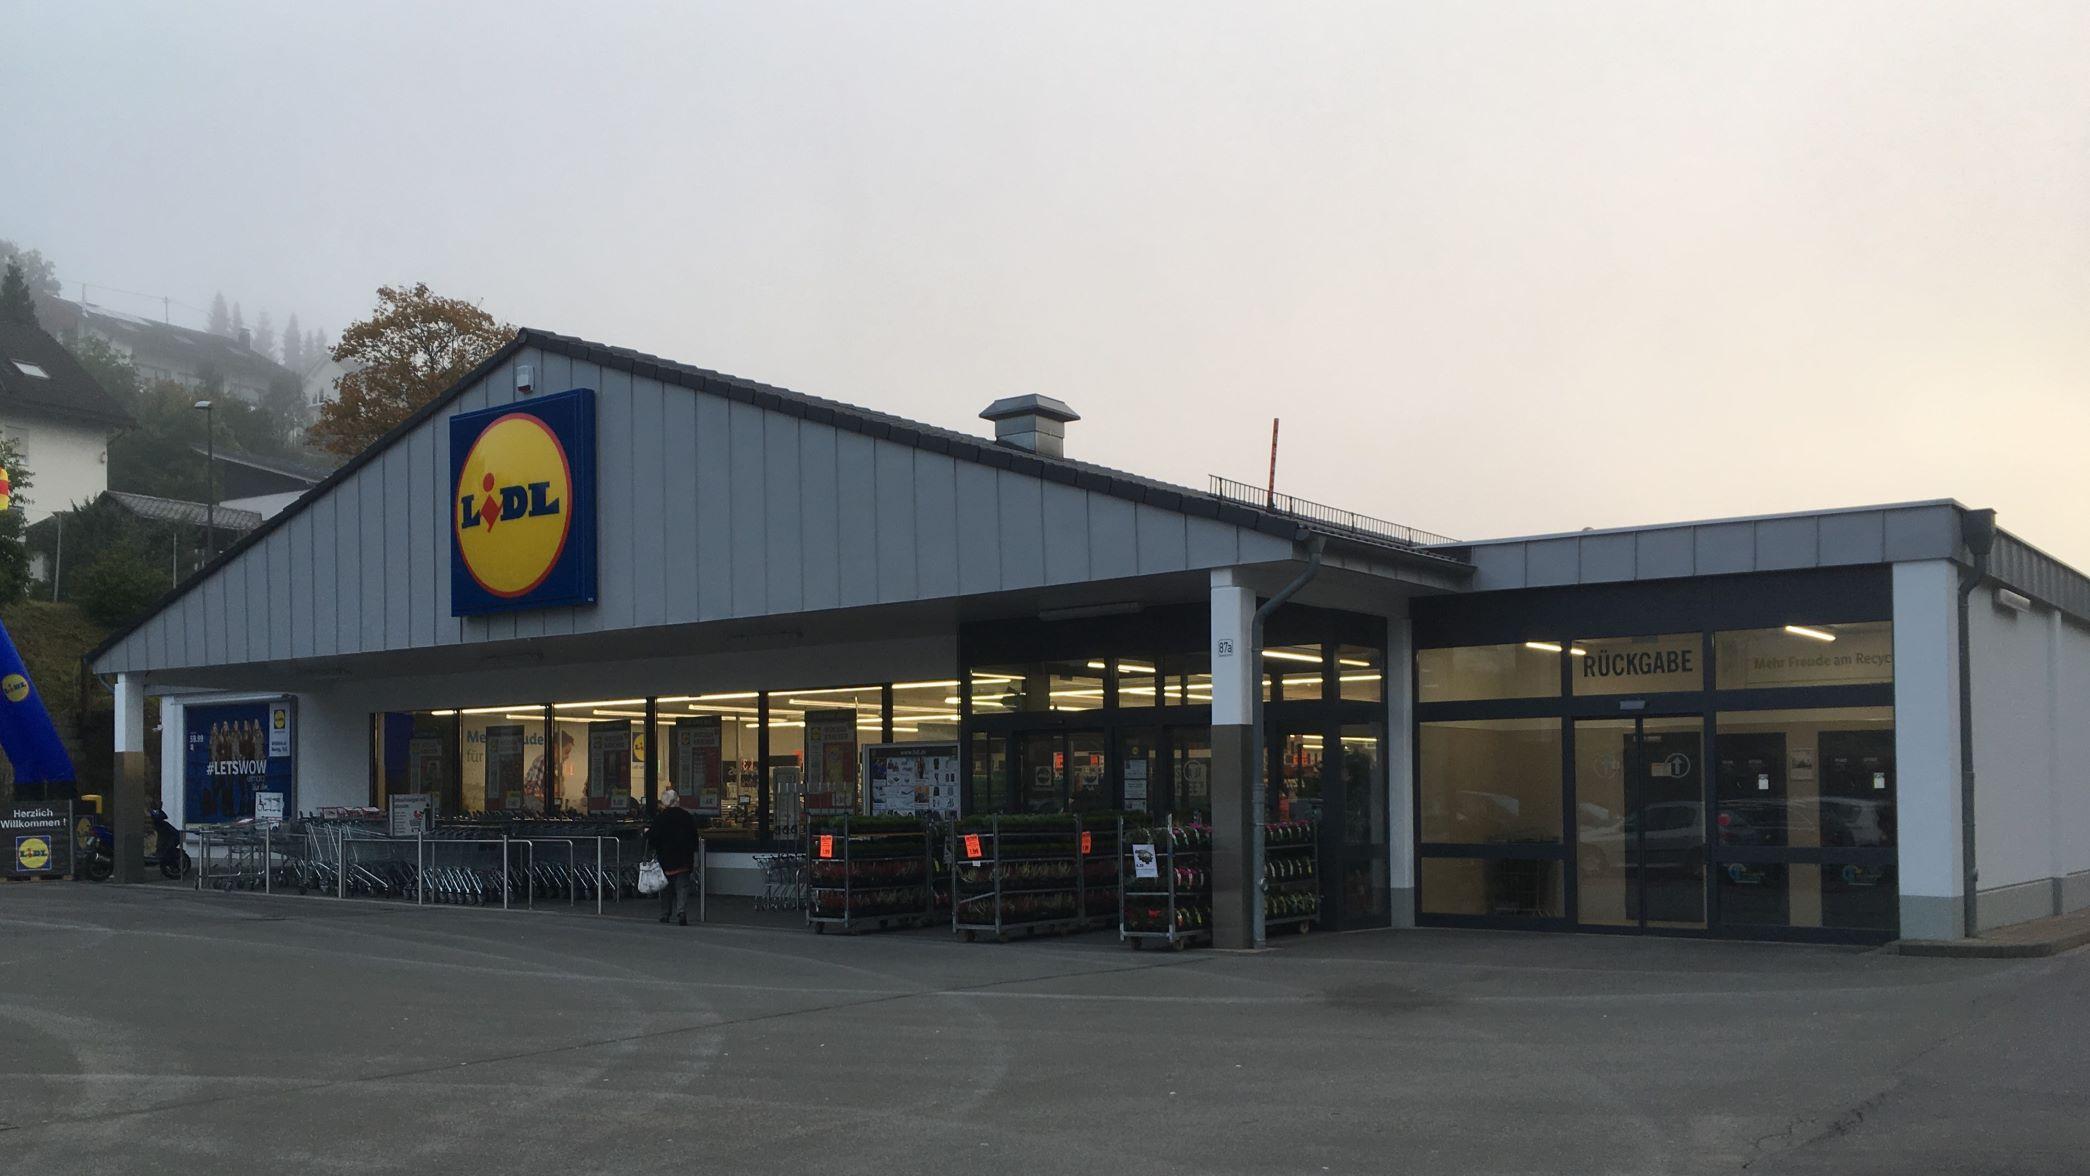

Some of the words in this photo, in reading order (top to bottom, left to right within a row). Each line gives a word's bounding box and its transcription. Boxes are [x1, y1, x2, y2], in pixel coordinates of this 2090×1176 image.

[1218, 641, 1233, 654] 87a
[1583, 649, 1693, 678] RÜCKGABE
[1754, 655, 1784, 670] Mehr
[1788, 653, 1830, 668] Freude
[1834, 656, 1852, 666] am
[466, 749, 484, 763] für
[206, 759, 267, 776] #LETSWOW
[13, 808, 53, 818] Herzlich
[0, 819, 60, 829] Willkommen
